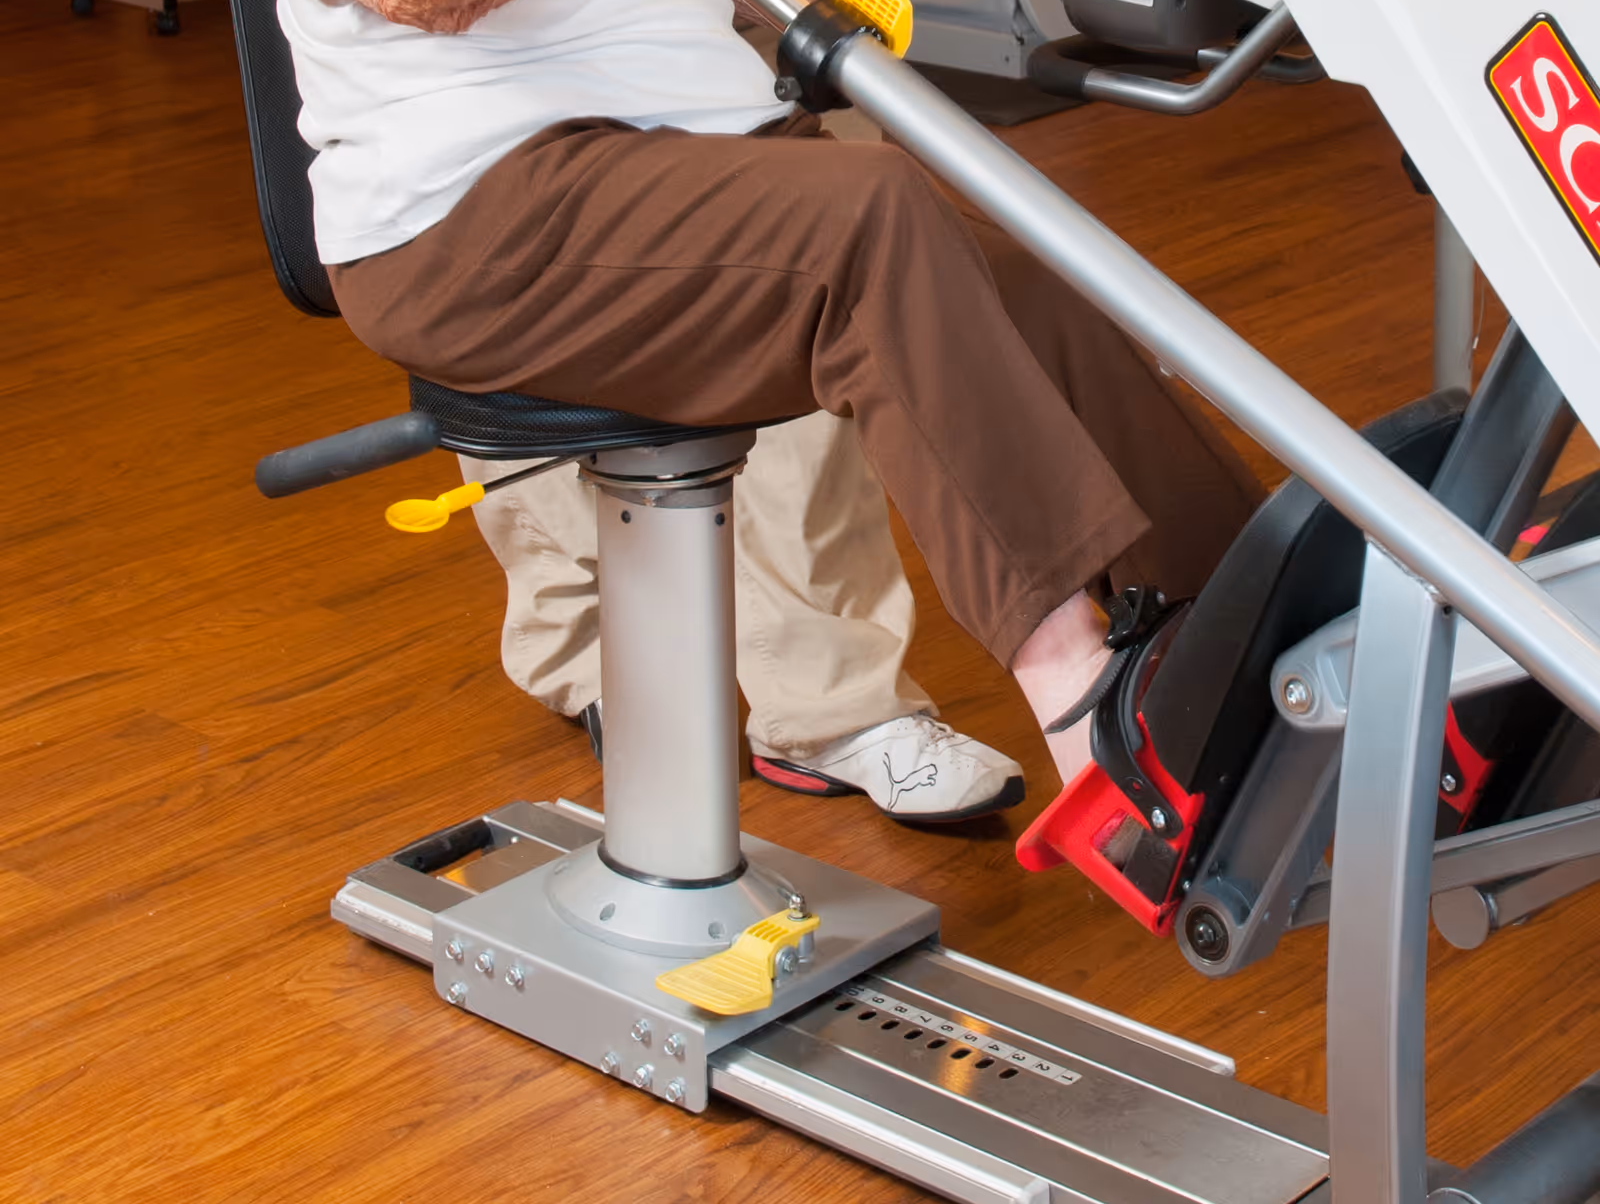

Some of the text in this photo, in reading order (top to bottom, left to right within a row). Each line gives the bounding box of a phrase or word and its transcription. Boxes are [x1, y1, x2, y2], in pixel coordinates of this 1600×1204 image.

[1510, 57, 1600, 230] SC
[894, 1005, 908, 1013] 8
[920, 1015, 932, 1023] 7
[964, 1033, 978, 1042] 5
[1011, 1053, 1026, 1061] 3
[1035, 1063, 1050, 1071] 2
[1061, 1074, 1073, 1082] 1
